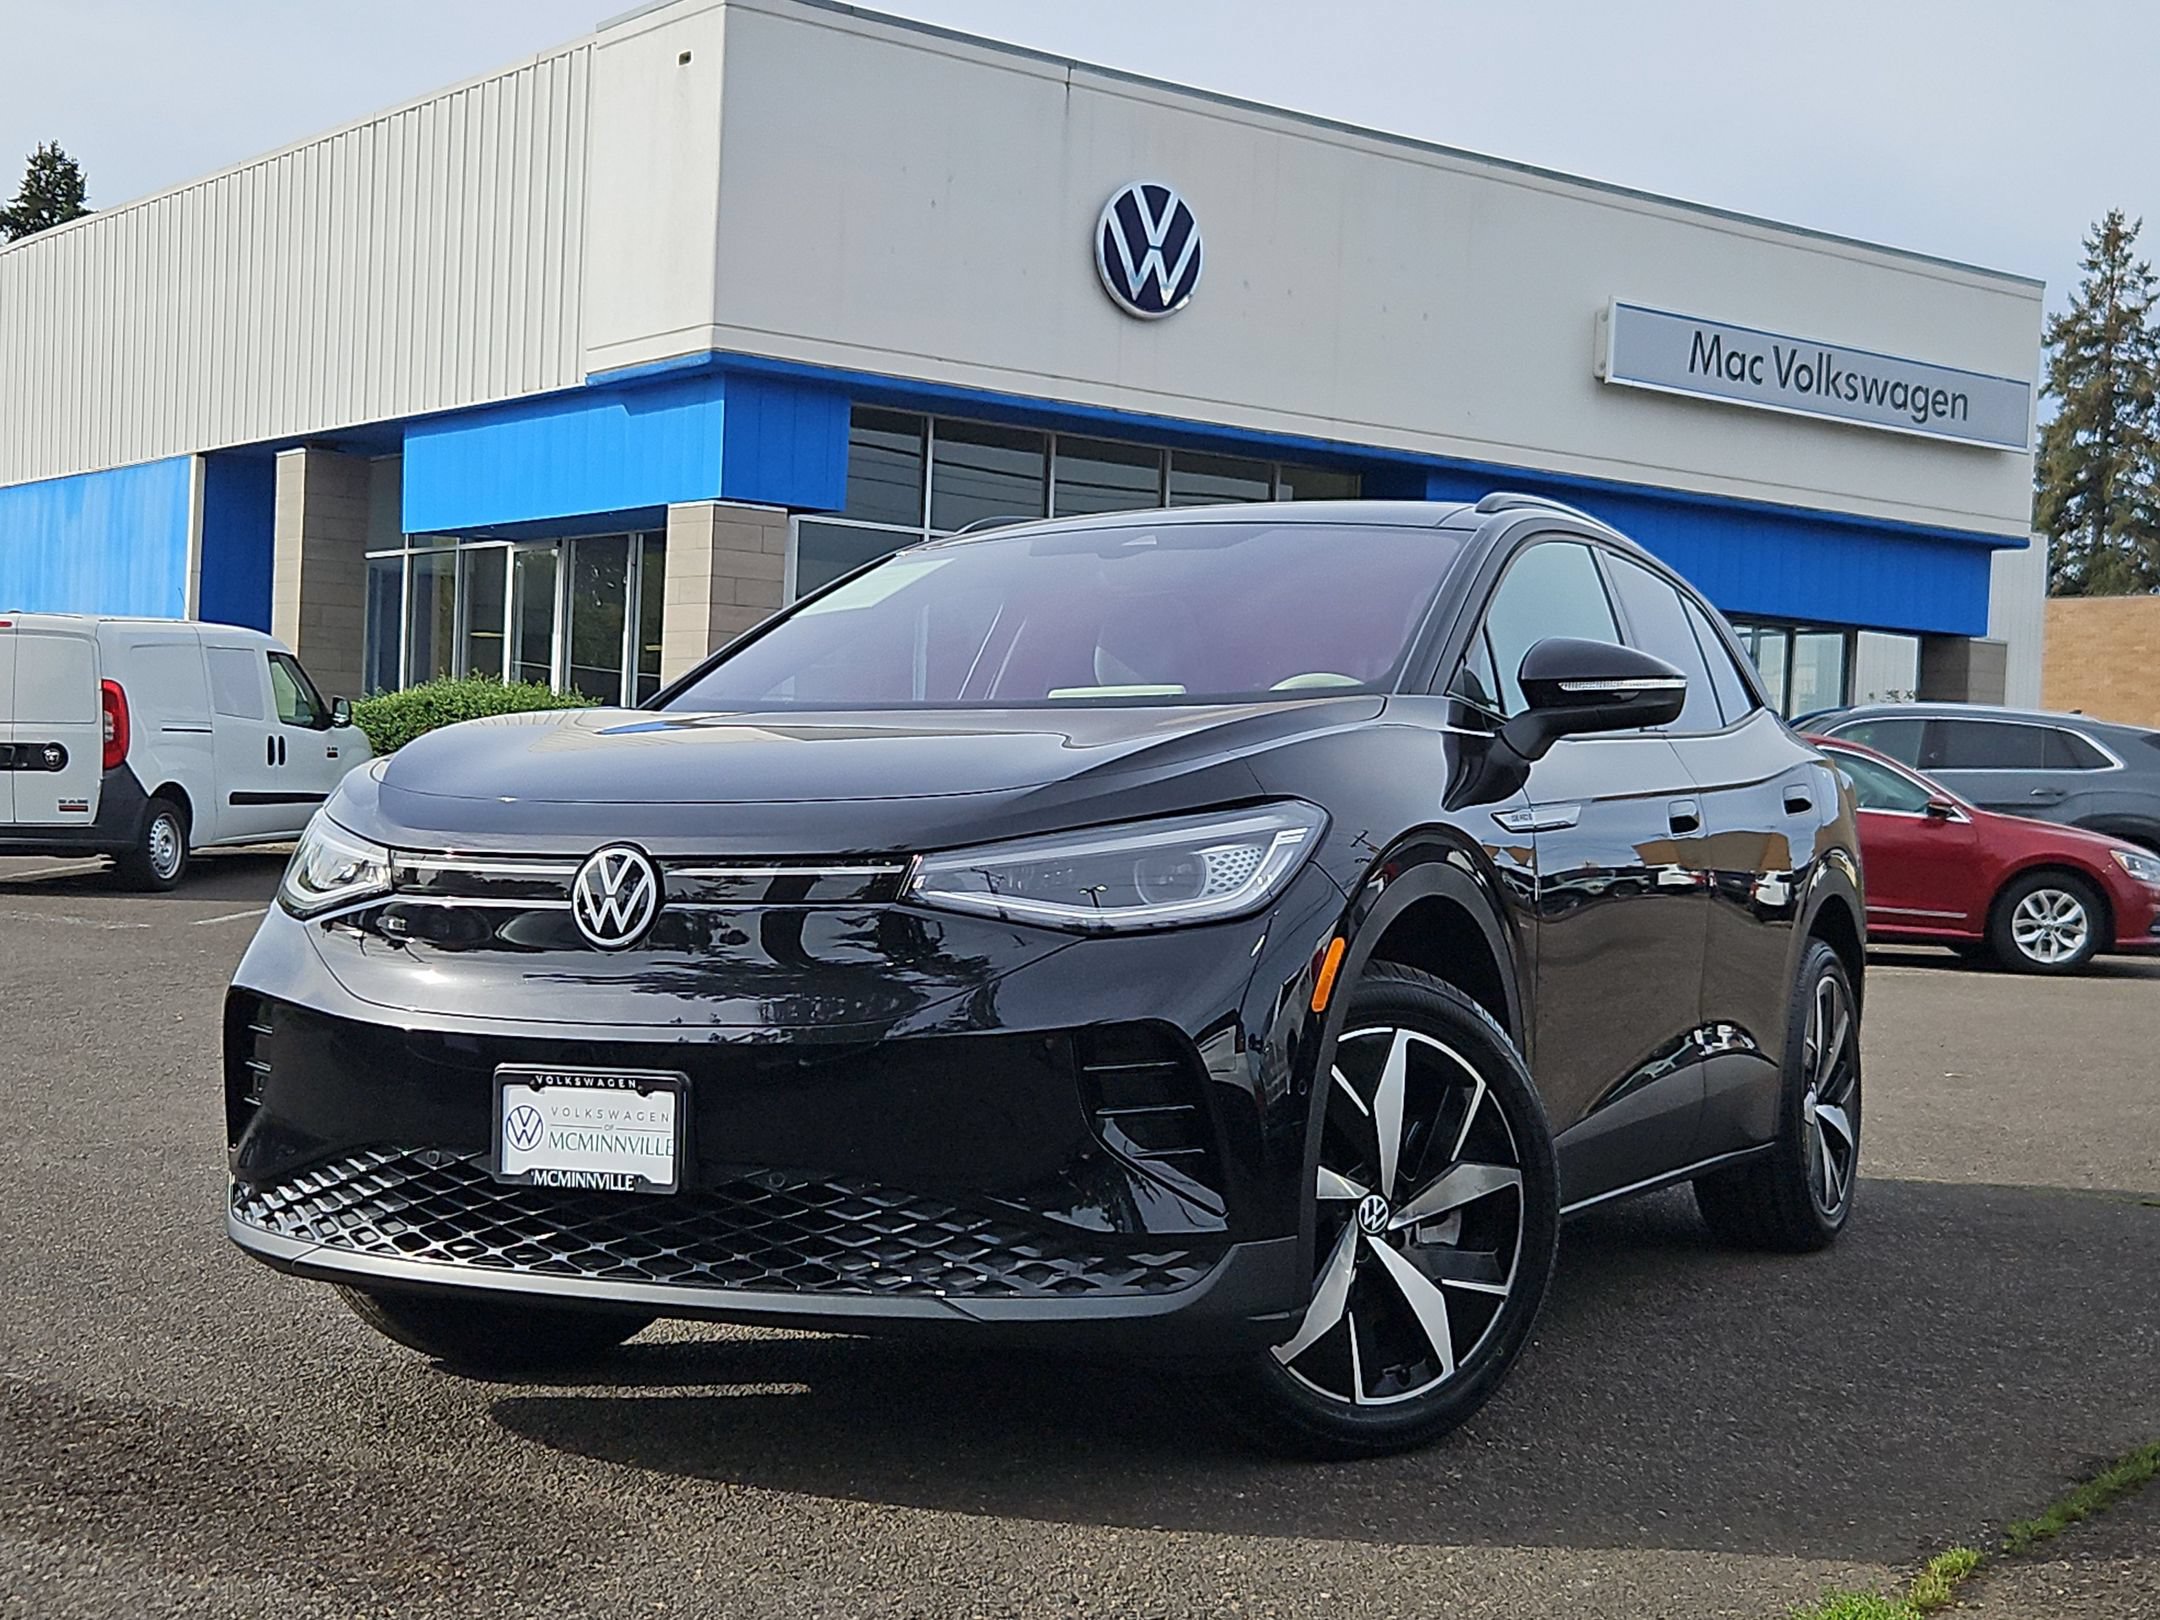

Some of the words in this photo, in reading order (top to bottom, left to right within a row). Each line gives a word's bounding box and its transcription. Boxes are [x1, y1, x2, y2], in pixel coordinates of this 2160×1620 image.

[1103, 183, 1201, 308] VW
[1689, 330, 1764, 385] Mac
[1772, 345, 1968, 425] Volkswagen
[576, 850, 654, 938] VW
[535, 1075, 636, 1089] VOLKSWAGEN
[551, 1106, 669, 1123] VOLKSWAGEN
[604, 1124, 615, 1132] OF
[548, 1131, 674, 1157] MCMINNVILLE
[532, 1170, 634, 1192] MCMINNVILLE
